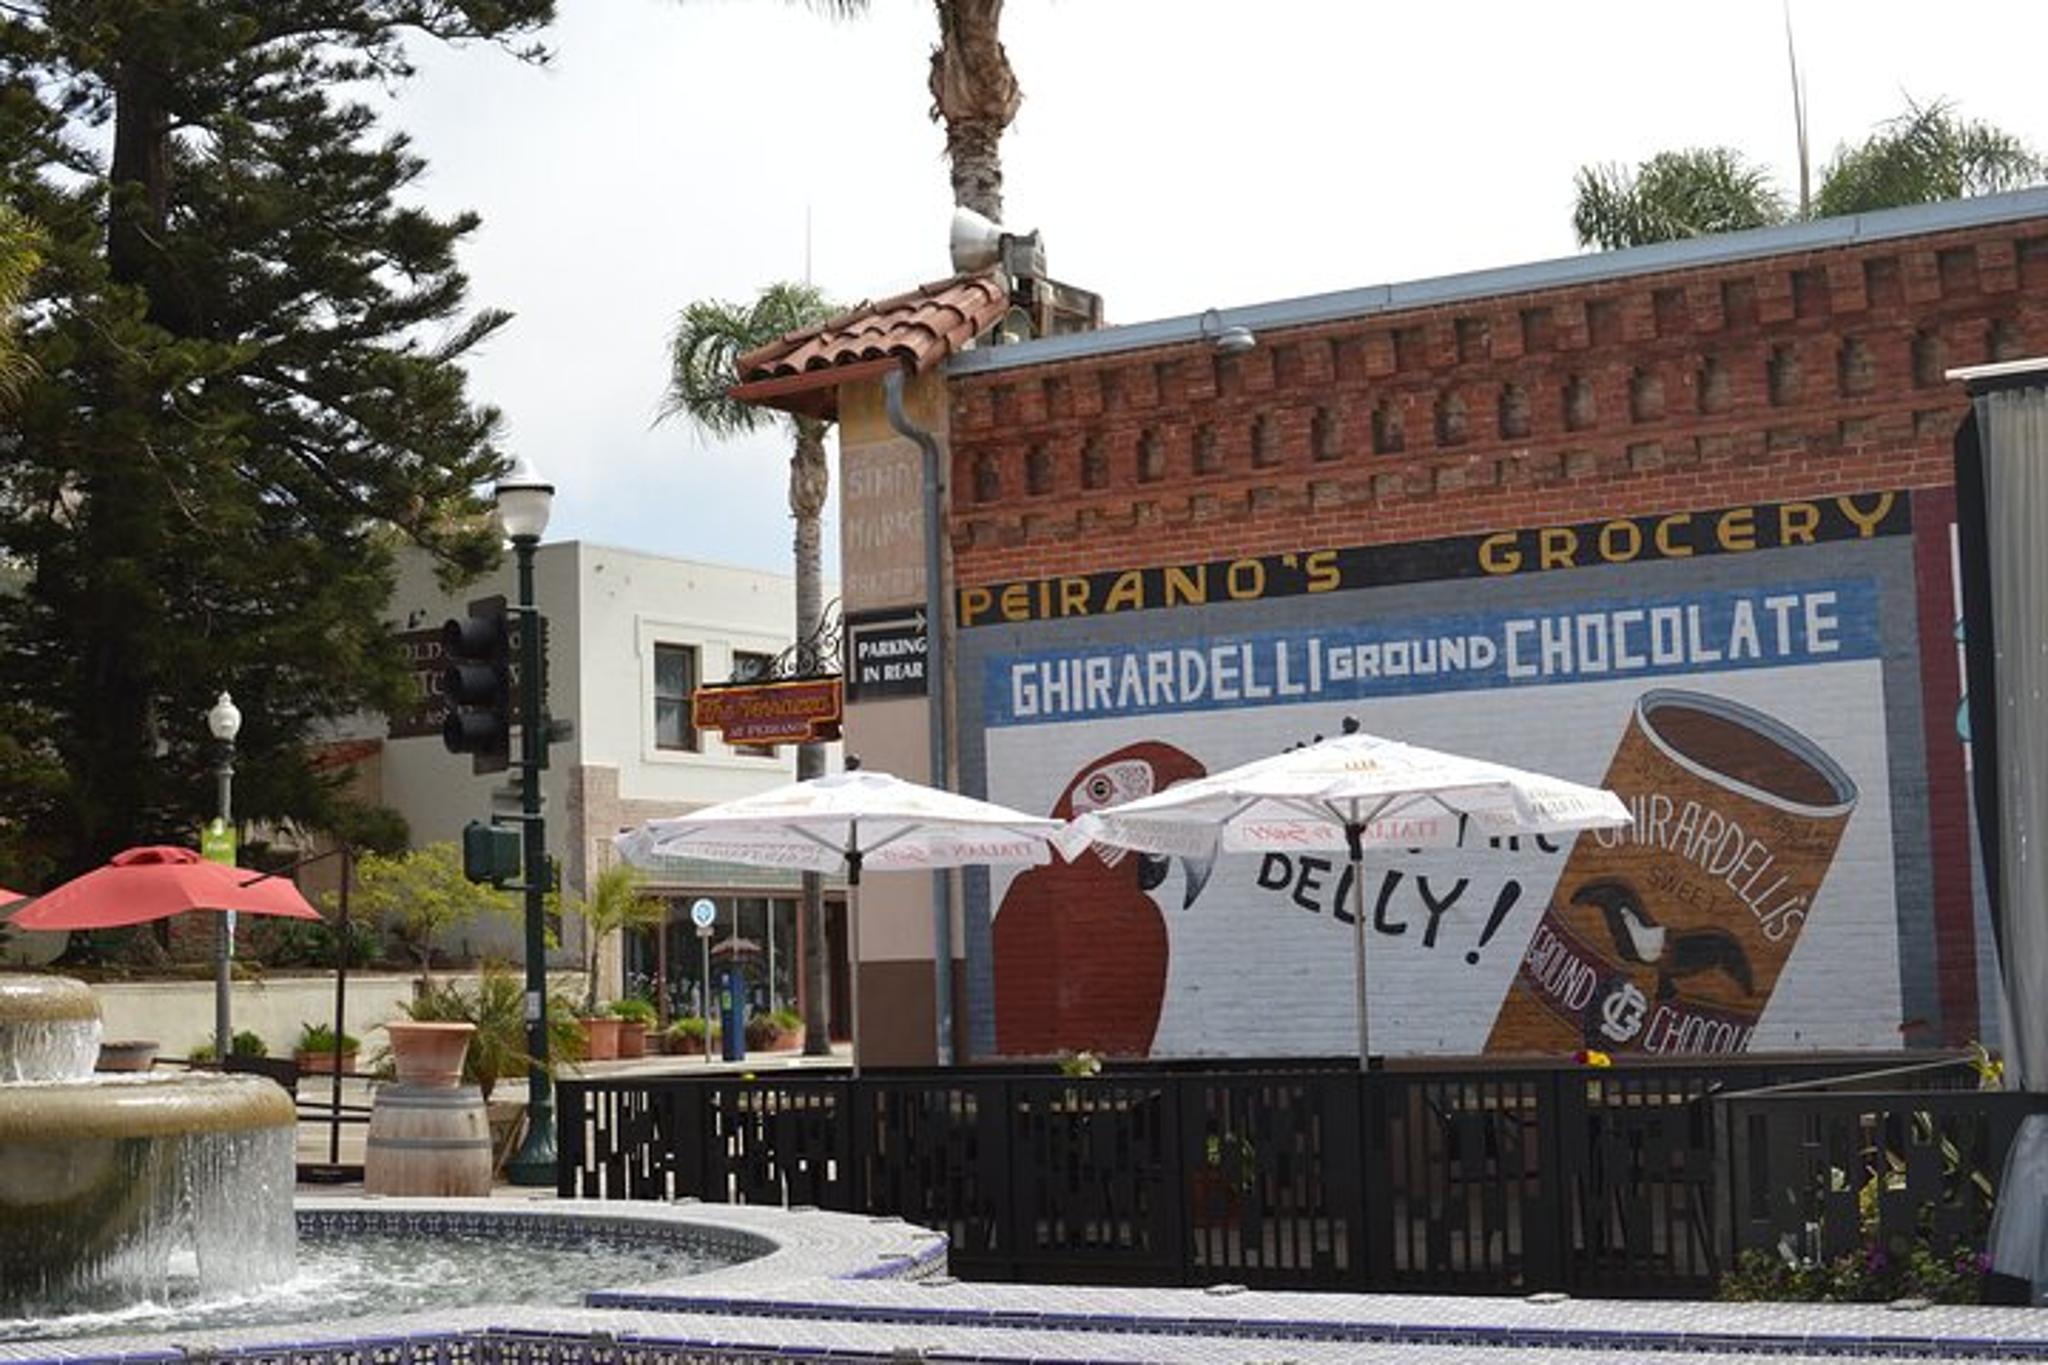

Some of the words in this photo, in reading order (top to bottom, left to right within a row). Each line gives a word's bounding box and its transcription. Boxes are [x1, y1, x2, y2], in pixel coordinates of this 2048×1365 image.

[960, 550, 1342, 627] PEIRANO'S
[1477, 491, 1895, 575] GROCERY
[858, 636, 928, 660] PARKING
[863, 665, 880, 683] IN
[884, 661, 924, 681] REAR
[1010, 638, 1322, 717] GHIRARDELLI
[1328, 634, 1497, 681] GROUND
[1504, 591, 1841, 679] CHOCOLATE
[1526, 923, 1598, 1011] GROUND
